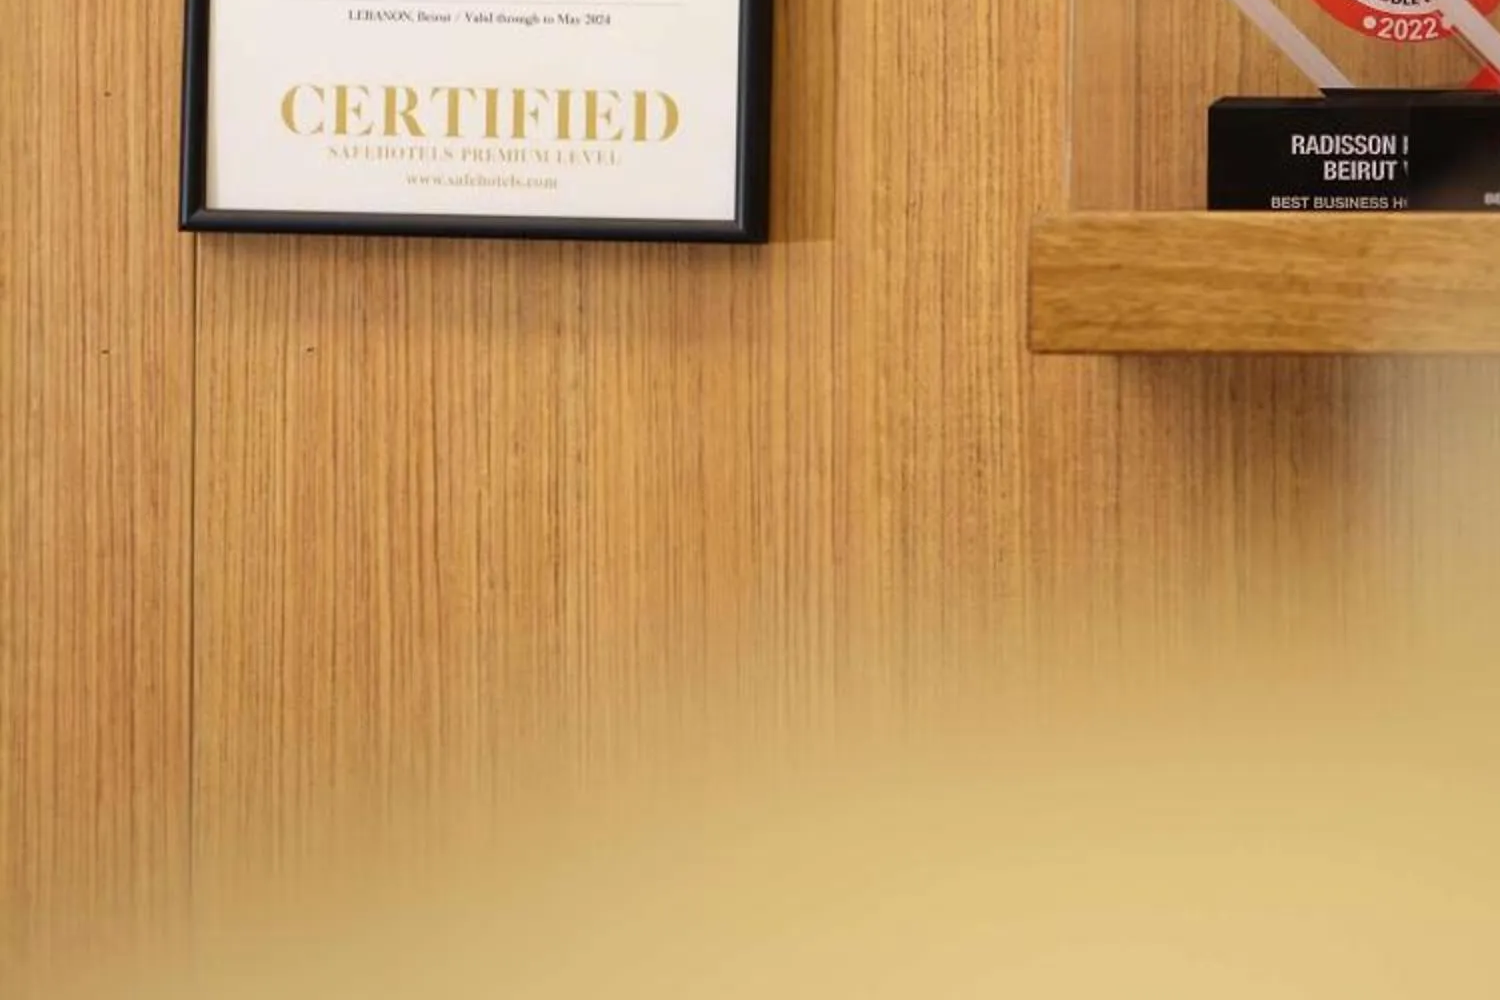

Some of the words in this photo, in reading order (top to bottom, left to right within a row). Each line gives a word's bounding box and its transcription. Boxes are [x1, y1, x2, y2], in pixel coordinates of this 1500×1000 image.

[417, 11, 451, 23] Beirut
[465, 11, 493, 23] Valid
[496, 13, 540, 27] through
[543, 15, 554, 25] to
[557, 14, 580, 27] May
[1376, 17, 1439, 40] 2022
[280, 84, 680, 143] CERTIFIED
[1291, 135, 1396, 155] RADISSON
[328, 145, 453, 162] SAFEHOTELS
[461, 148, 550, 164] PREMIUM
[557, 150, 622, 166] LEVEL
[1323, 160, 1398, 181] BEIRUT
[405, 172, 558, 190] www.safehotels.com
[1271, 196, 1310, 209] BEST
[1313, 196, 1389, 209] BUSINESS
